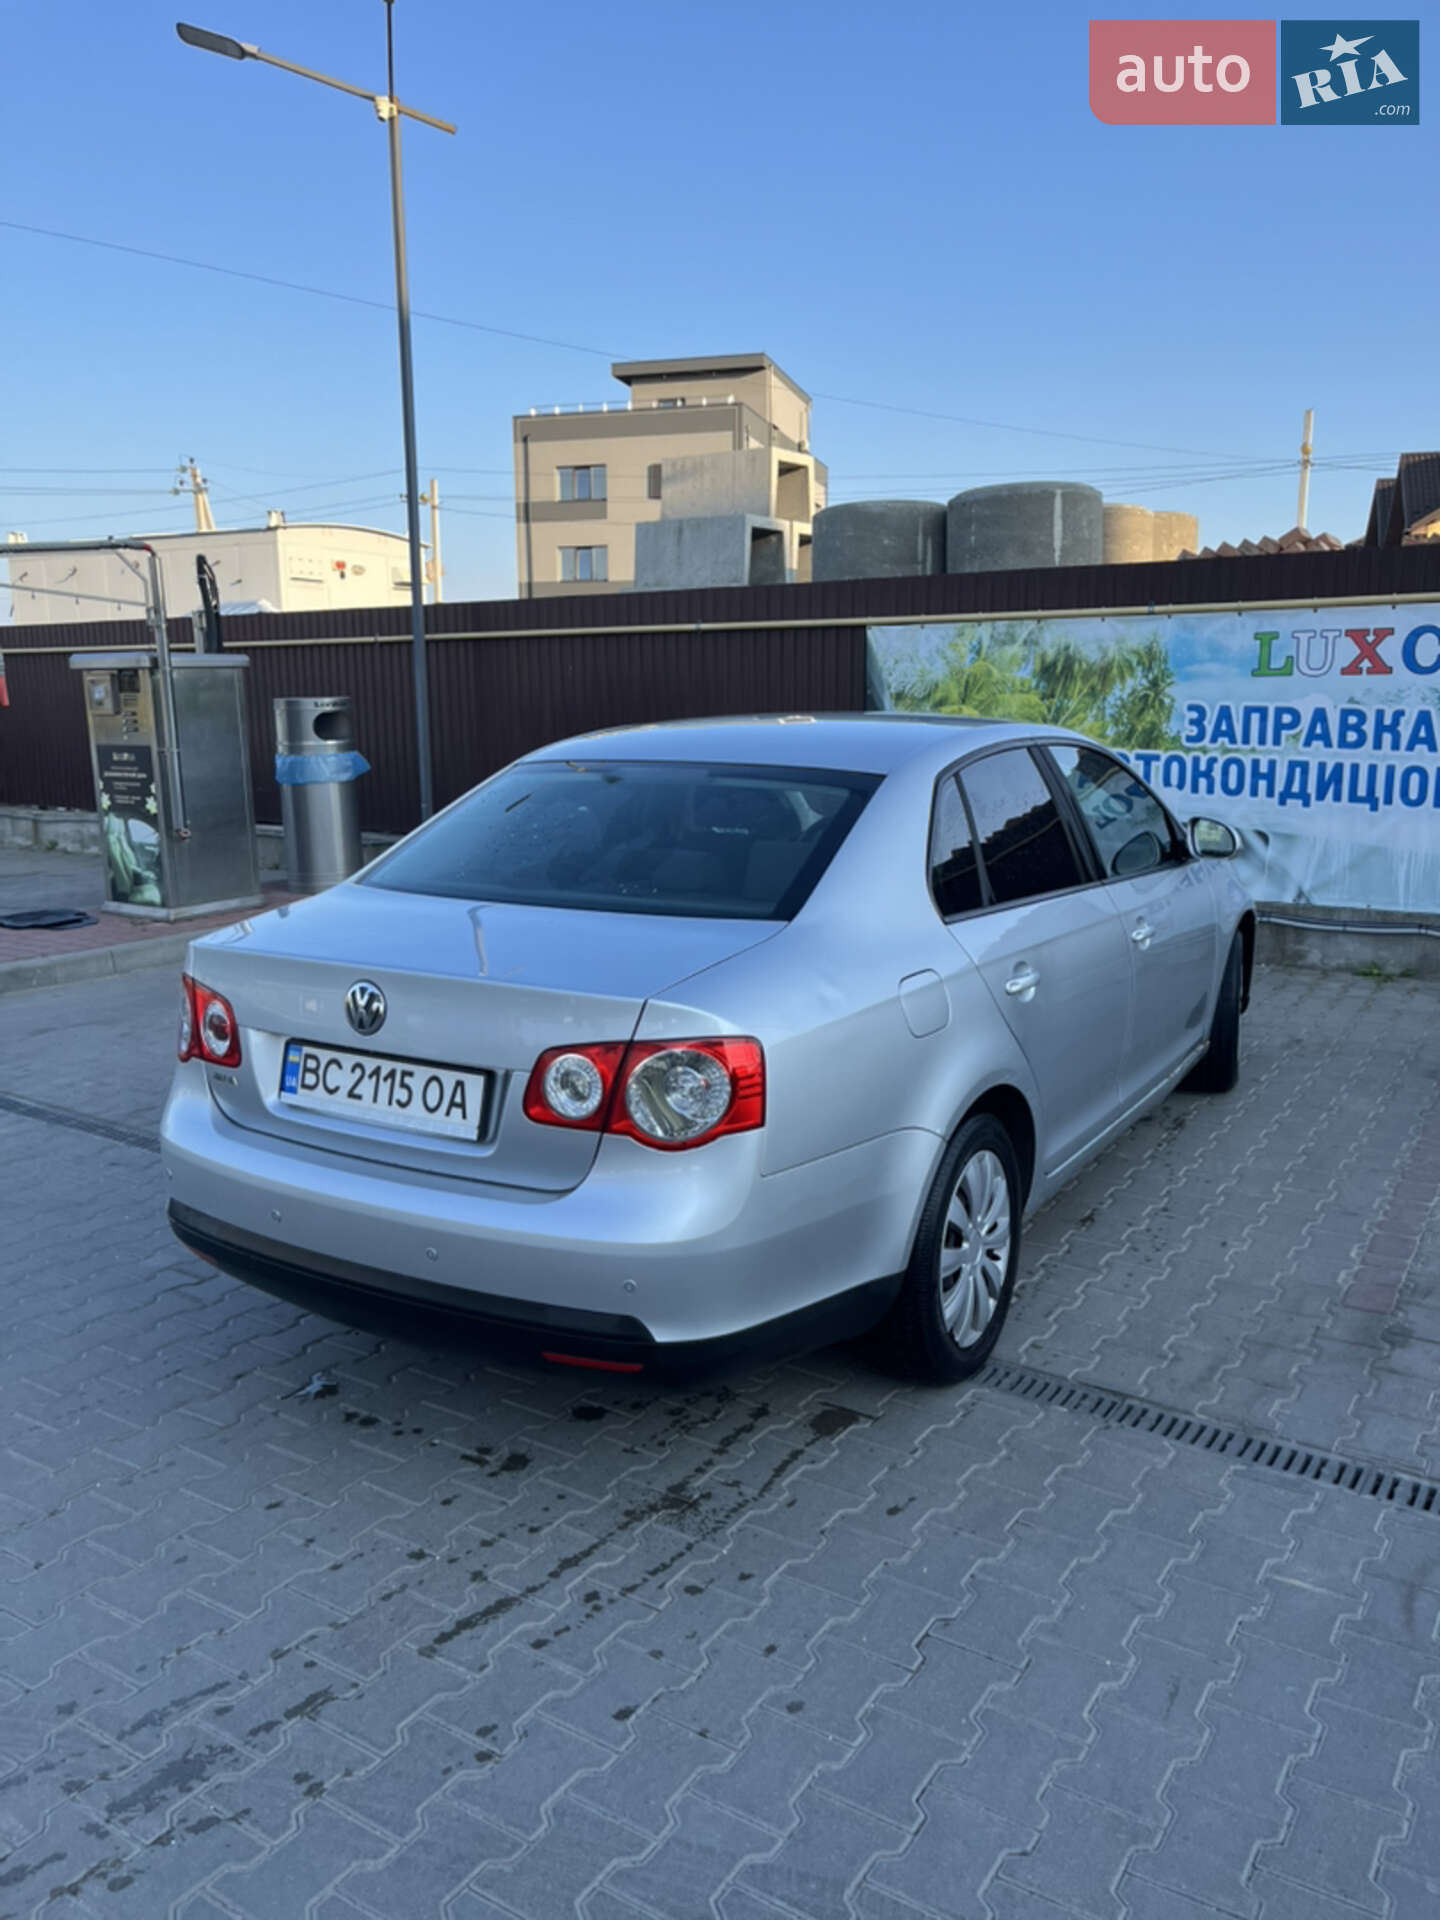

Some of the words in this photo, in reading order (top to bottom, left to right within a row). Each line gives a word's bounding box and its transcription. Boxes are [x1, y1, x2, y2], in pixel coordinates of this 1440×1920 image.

[1184, 703, 1438, 753] ЗАПРАВКА
[1115, 751, 1440, 812] ТОКОНДИЦІО
[300, 1053, 343, 1095] BC
[347, 1062, 414, 1109] 2115
[422, 1074, 467, 1120] OA
